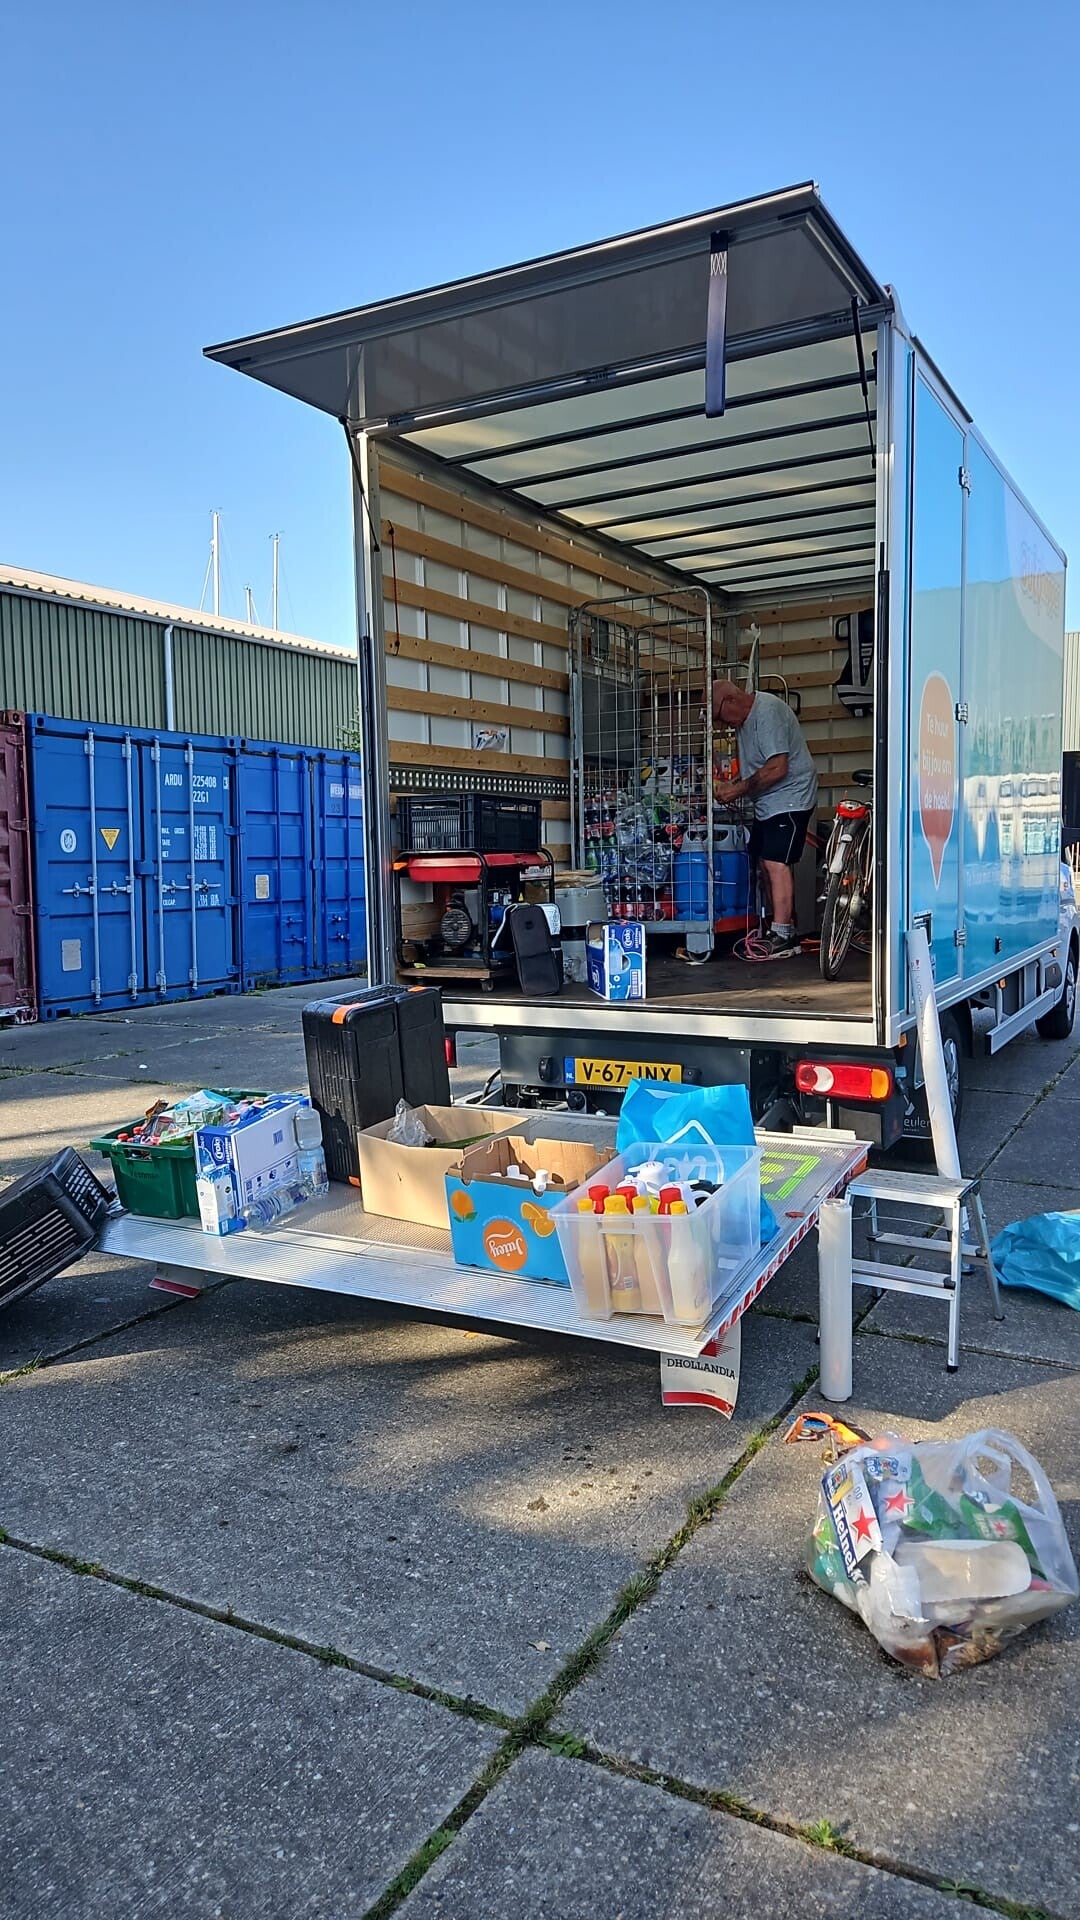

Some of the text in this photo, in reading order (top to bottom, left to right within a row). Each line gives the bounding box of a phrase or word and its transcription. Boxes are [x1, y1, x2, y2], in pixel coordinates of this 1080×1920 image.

[165, 774, 183, 786] ARDU
[193, 775, 217, 788] 225408
[193, 791, 209, 803] 22G1
[489, 1238, 523, 1257] Juicy
[667, 1358, 735, 1380] DHOLLANDIA
